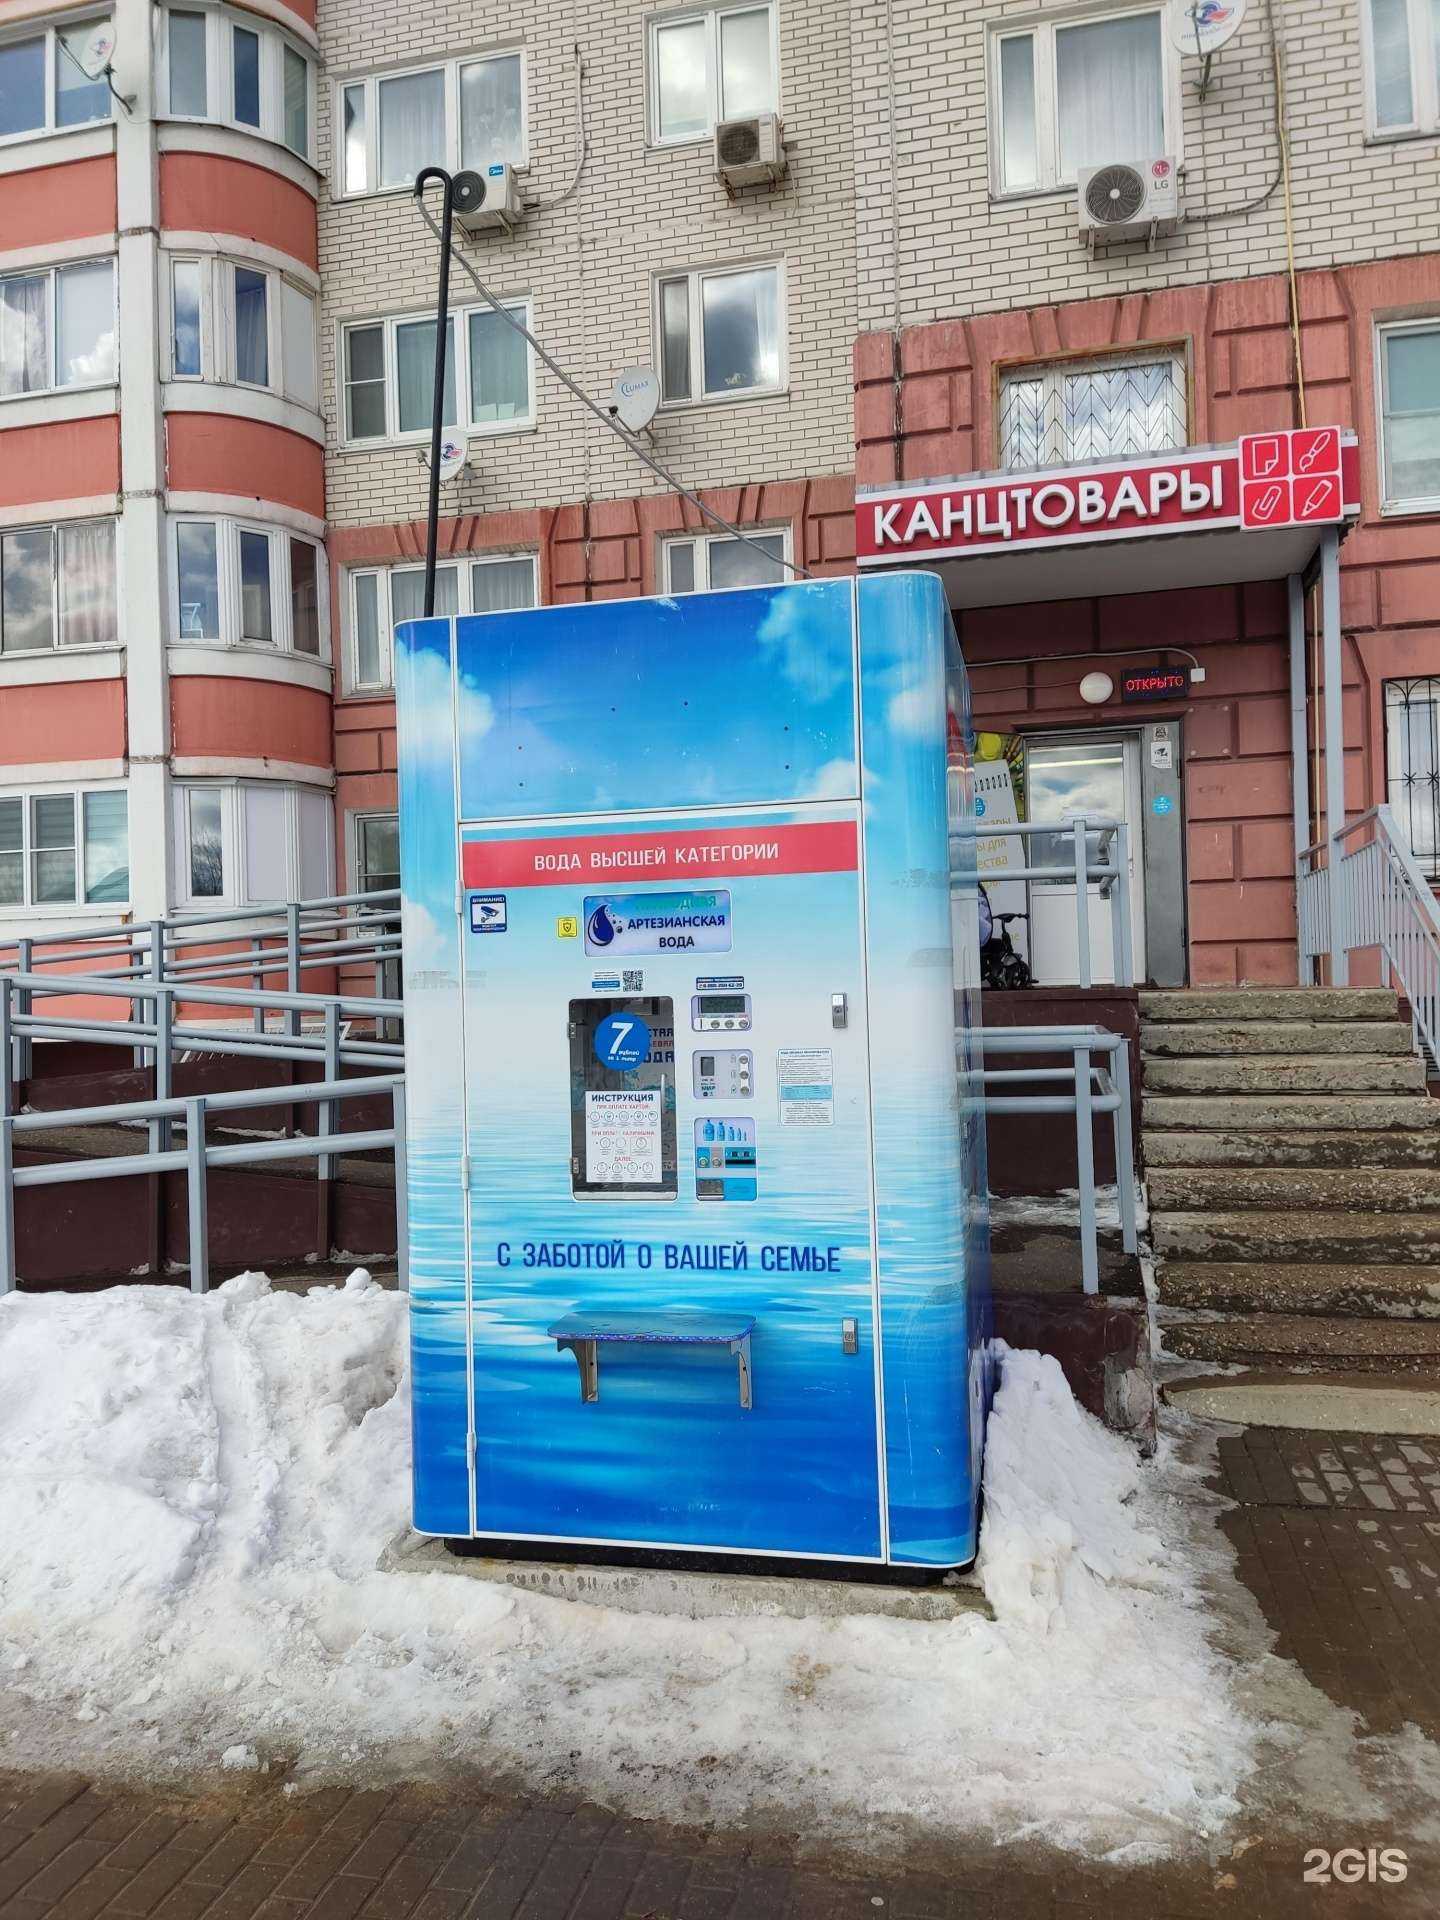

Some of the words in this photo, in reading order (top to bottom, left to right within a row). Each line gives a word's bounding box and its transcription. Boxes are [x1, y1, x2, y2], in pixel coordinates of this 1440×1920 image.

[1154, 180, 1168, 190] LG
[874, 465, 1223, 547] КАНЦТОВАРЫ
[1126, 675, 1184, 691] ОТКРЫТО
[534, 854, 581, 872] ВОДА
[590, 846, 666, 868] ВЫСШЕЙ
[675, 843, 779, 863] КАТЕГОРИИ
[627, 915, 725, 930] АРТЕЗИАНСКАЯ
[659, 936, 695, 948] ВОДА
[609, 1021, 634, 1055] 7
[591, 1093, 654, 1103] ИНСТРУКЦИЯ
[497, 1242, 511, 1268] С
[522, 1239, 626, 1269] ЗАБОТОЙ
[637, 1243, 652, 1269] О
[664, 1241, 748, 1271] ВАШЕЙ
[761, 1245, 841, 1272] СЕМЬЕ
